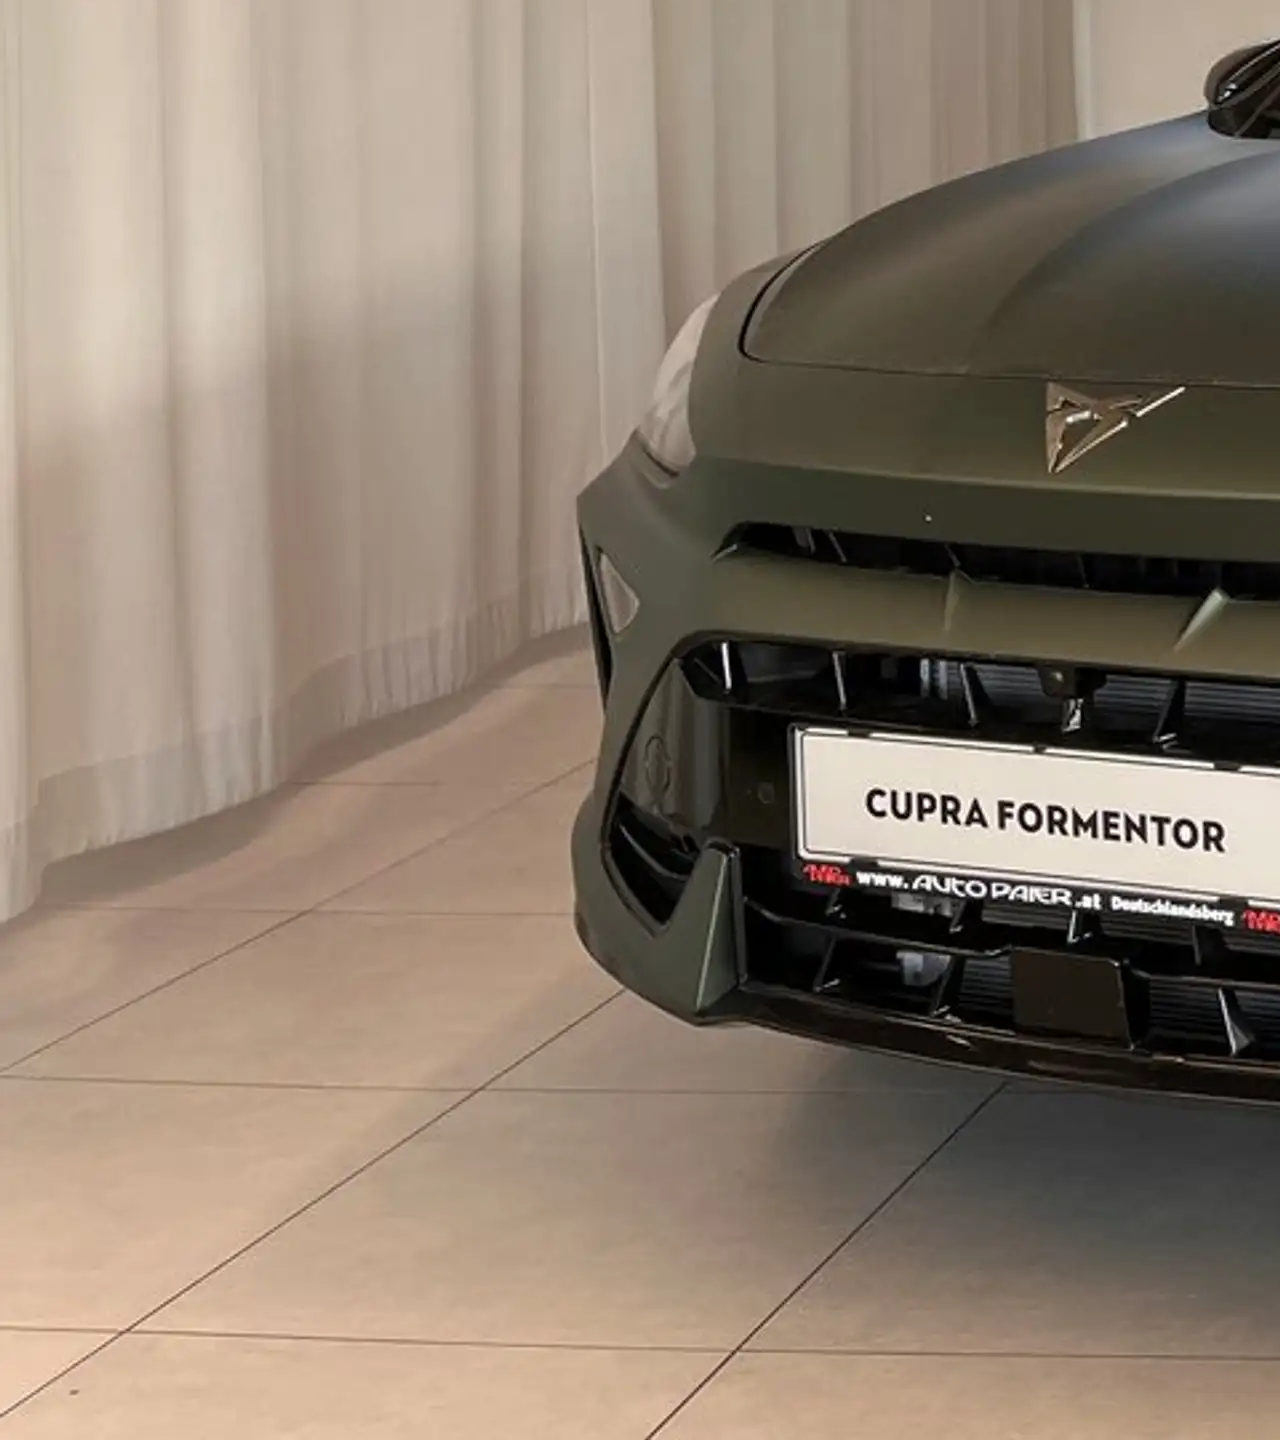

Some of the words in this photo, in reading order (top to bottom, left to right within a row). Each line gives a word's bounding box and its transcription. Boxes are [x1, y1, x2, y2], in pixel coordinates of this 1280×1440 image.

[865, 787, 988, 829] CUPRA
[997, 799, 1226, 854] FORMENTOR
[1110, 895, 1235, 927] Deutschlandsberg
